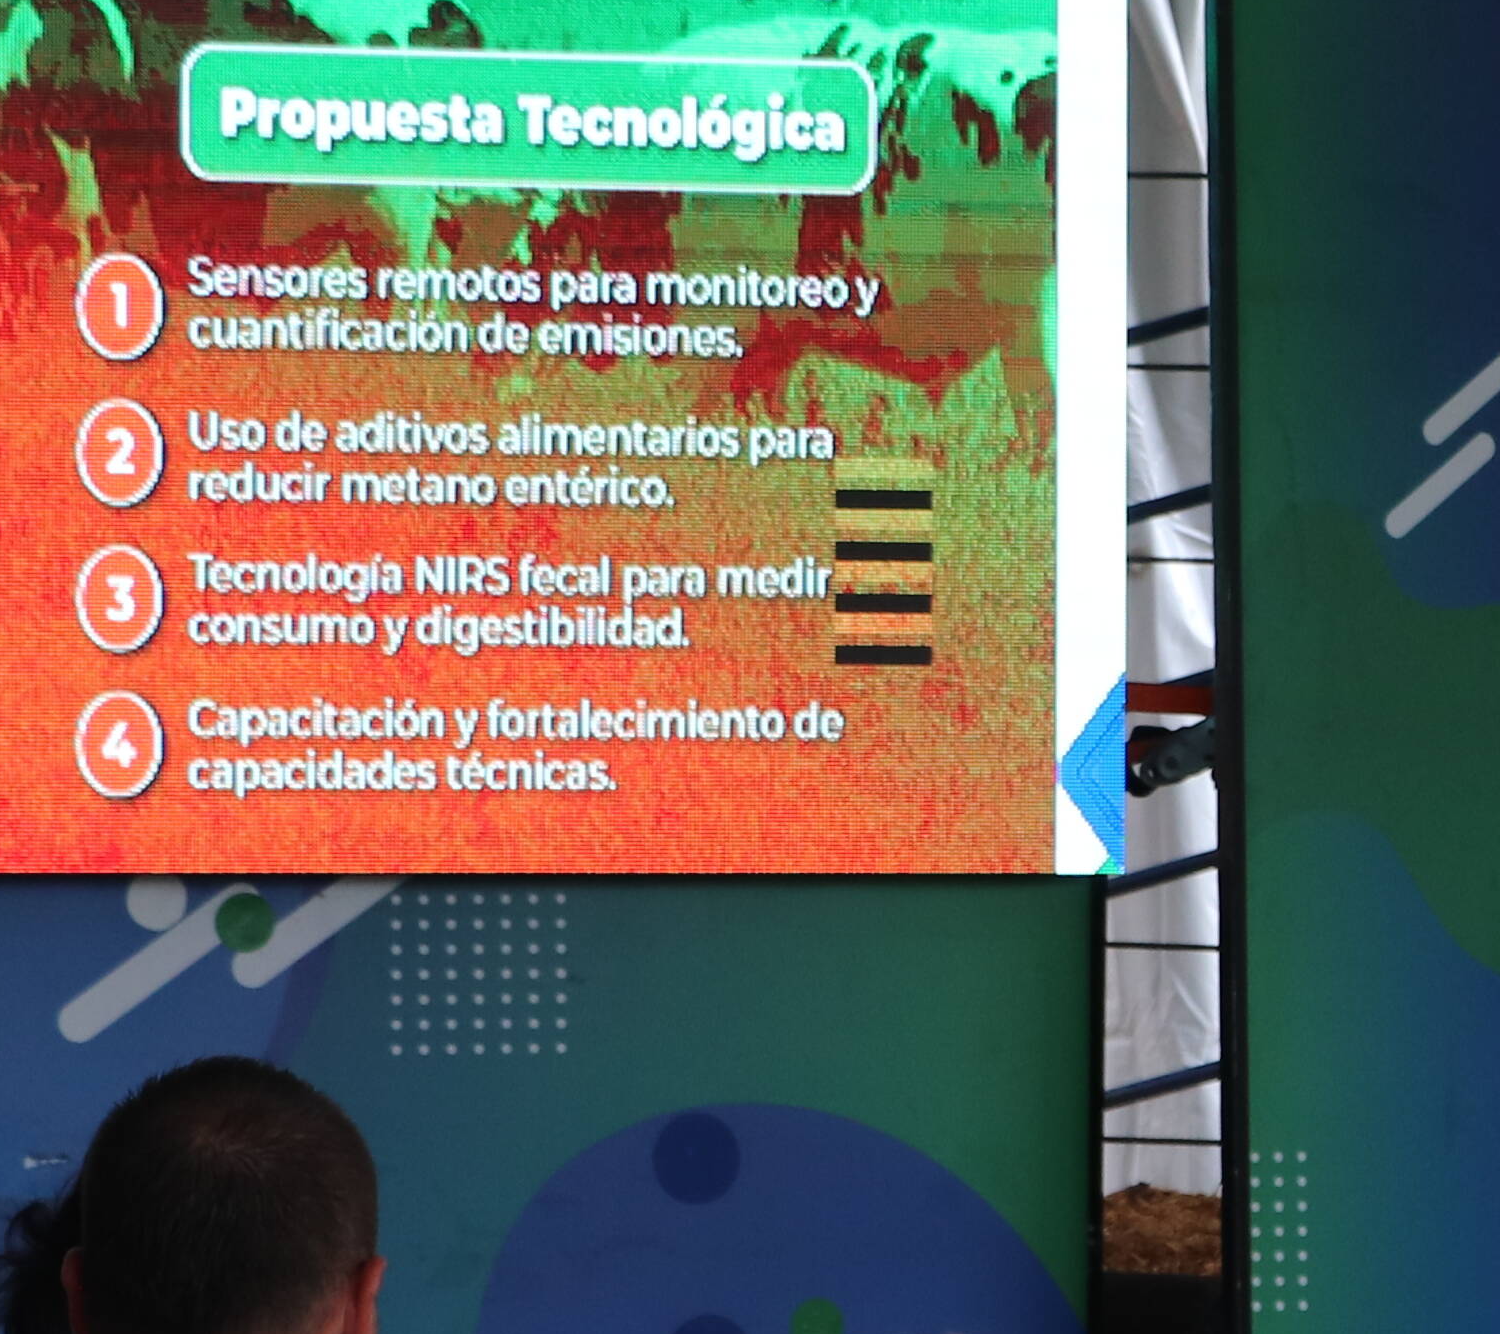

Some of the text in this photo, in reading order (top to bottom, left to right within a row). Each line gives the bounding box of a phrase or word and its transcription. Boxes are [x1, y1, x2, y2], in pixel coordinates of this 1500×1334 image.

[220, 86, 845, 162] Propuesta Tecnológica
[110, 257, 879, 327] 1 Sensores remotos para monitoreo y
[188, 311, 744, 358] cuantificación de emisiones.
[106, 411, 834, 476] 2 Uso de aditivos alimentarios para
[188, 467, 675, 508] reducir metano entérico.
[106, 554, 833, 622] 3 Tecnología NIRS fecal para medir
[188, 607, 689, 656] consumo y digestibilidad.
[101, 698, 844, 767] 4 Capacitación y fortalecimiento de
[188, 752, 617, 799] capacidades técnicas.
